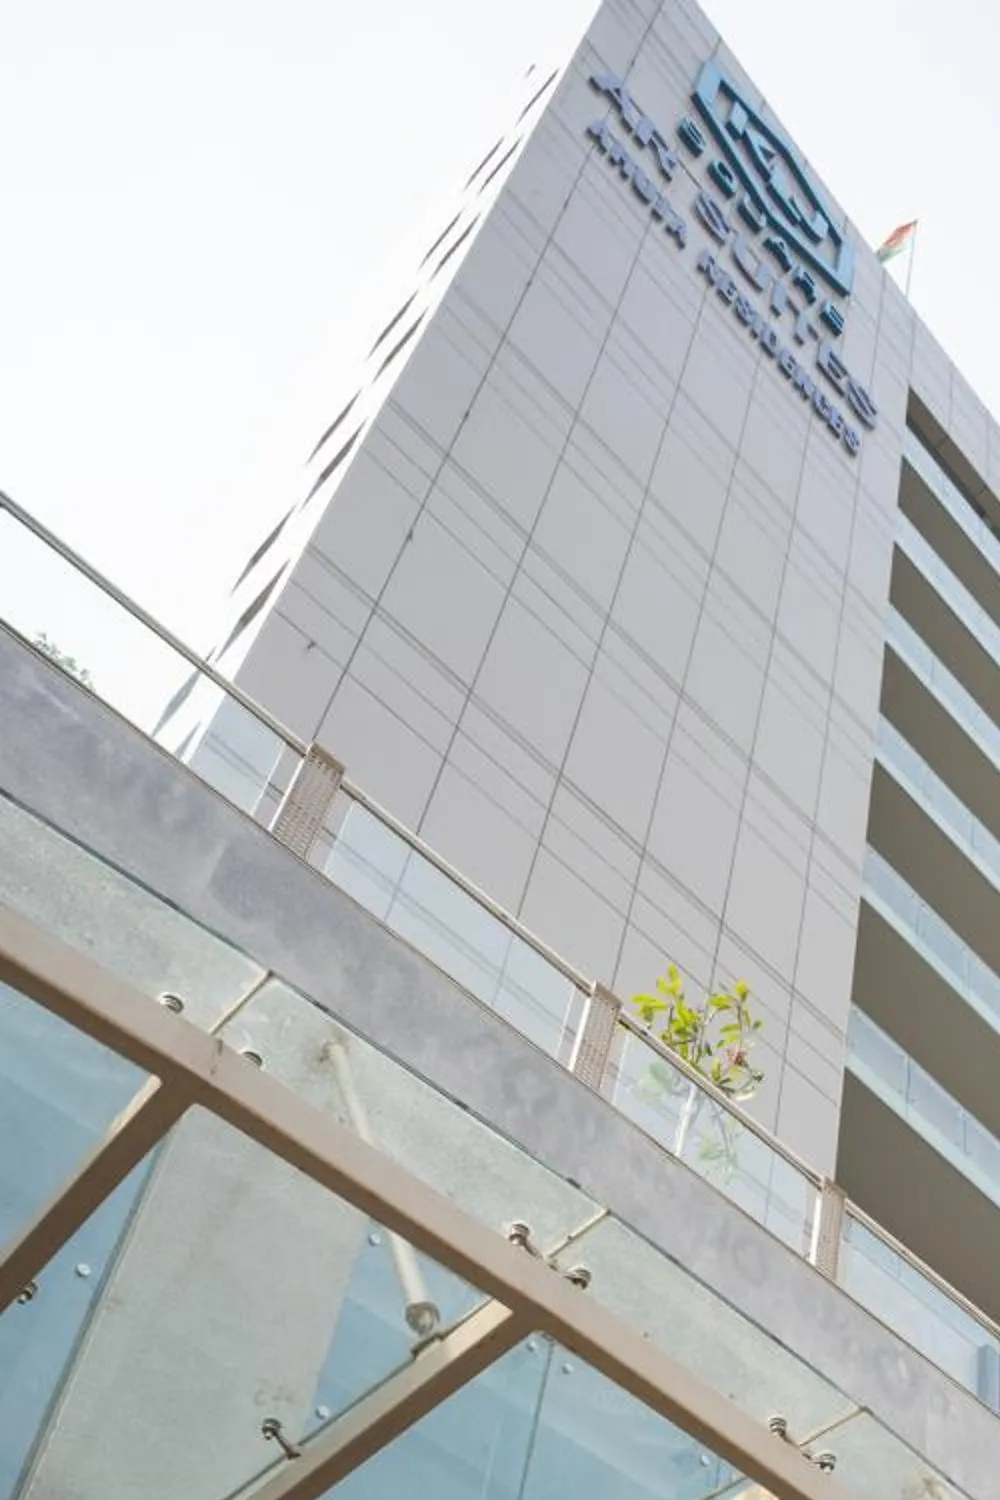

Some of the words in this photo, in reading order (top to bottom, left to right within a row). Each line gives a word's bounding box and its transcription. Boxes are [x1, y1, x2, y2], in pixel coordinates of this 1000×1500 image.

[677, 116, 845, 337] SQUARE
[694, 190, 878, 430] SUITES
[697, 248, 862, 456] RESIDENCES
